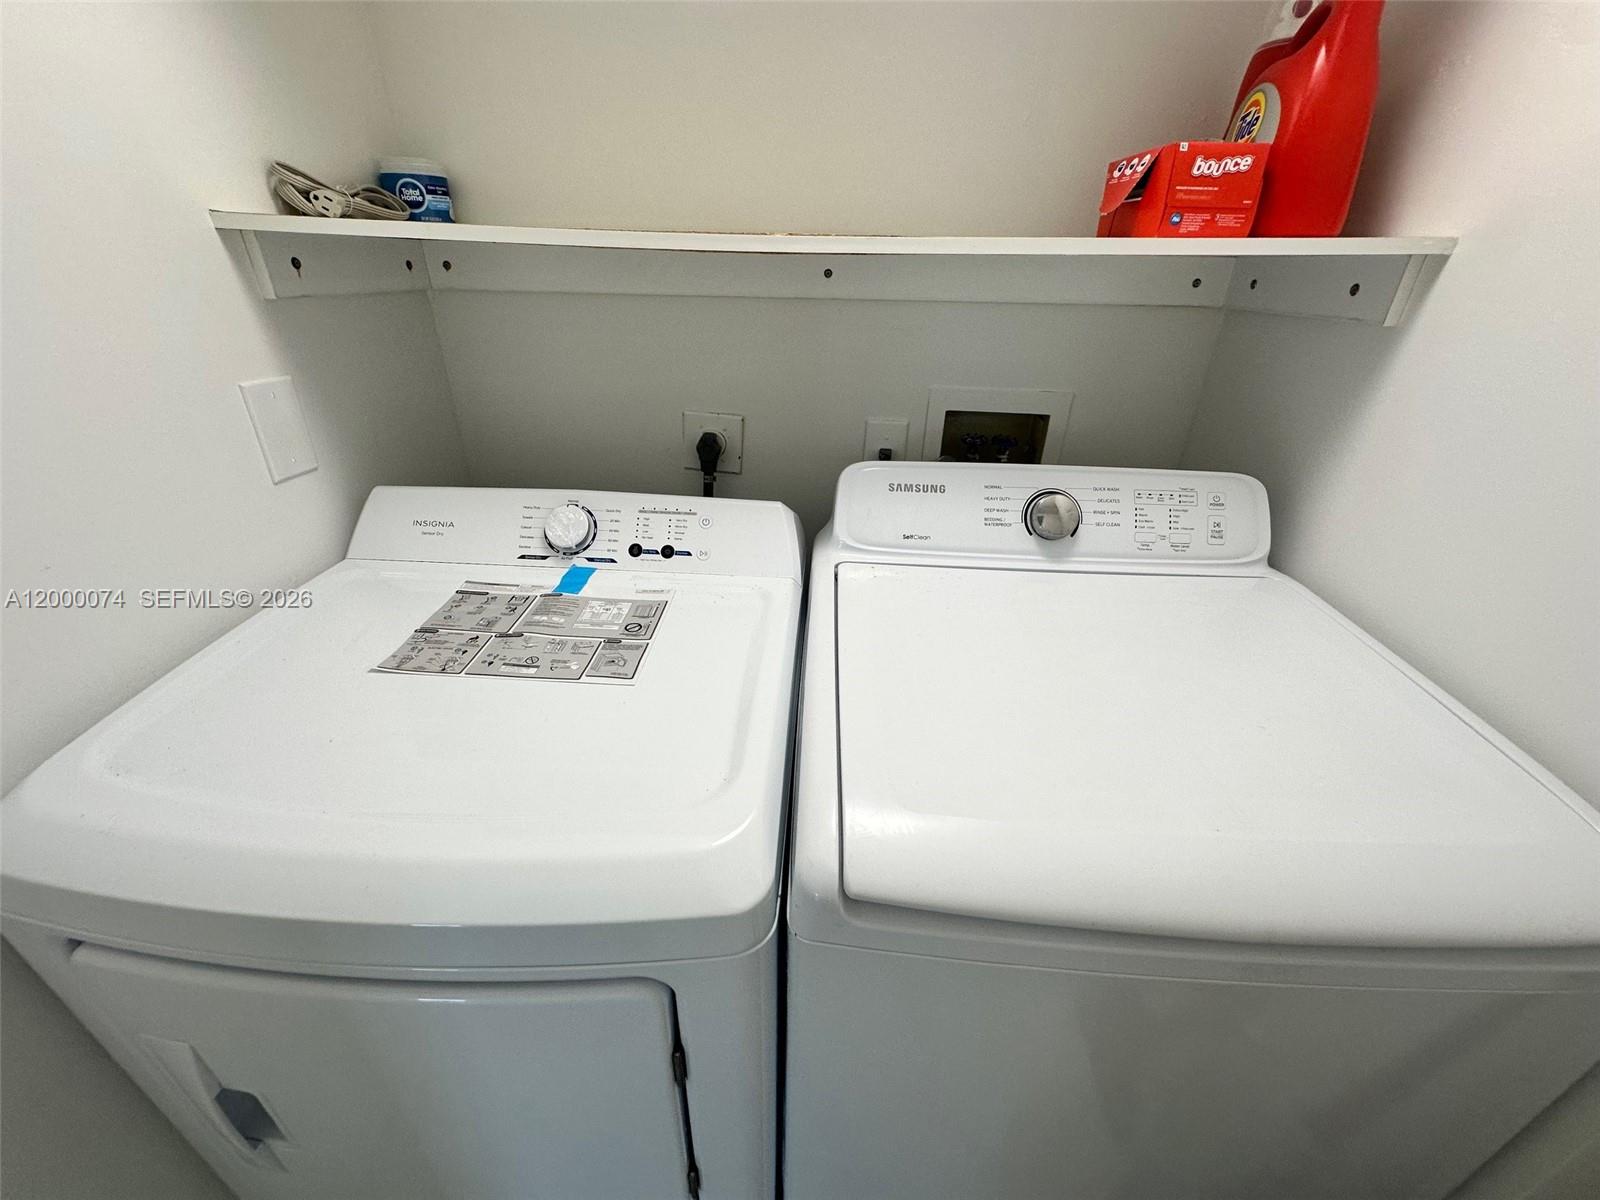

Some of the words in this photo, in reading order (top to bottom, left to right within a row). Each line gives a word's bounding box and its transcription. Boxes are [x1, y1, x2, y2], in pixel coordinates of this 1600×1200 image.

[1234, 108, 1261, 142] Tide
[1192, 155, 1254, 177] bounce
[401, 187, 420, 196] Total
[401, 194, 423, 202] Home
[888, 482, 946, 494] SAMSUNG
[412, 519, 455, 528] INSIGNIA
[902, 533, 931, 541] SelfClean
